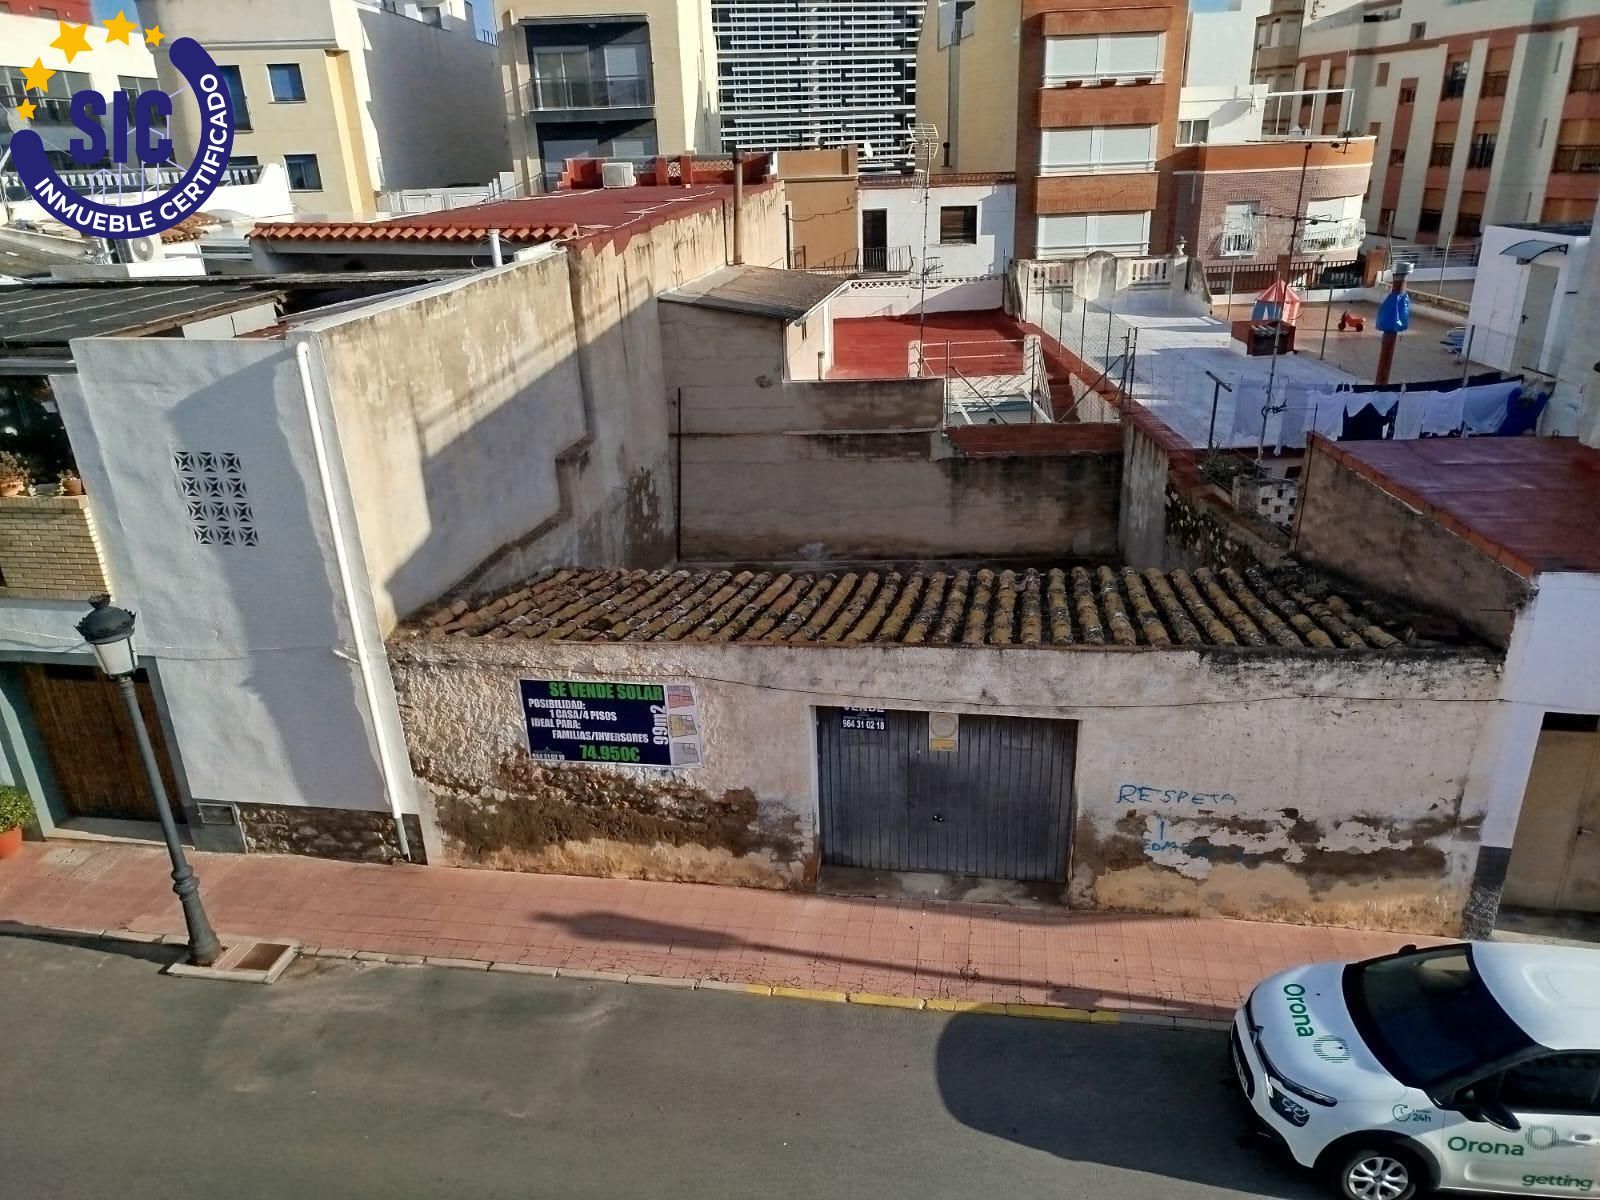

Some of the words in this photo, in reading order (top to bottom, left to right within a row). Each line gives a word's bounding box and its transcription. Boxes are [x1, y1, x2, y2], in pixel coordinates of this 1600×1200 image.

[549, 682, 567, 697] SE
[569, 683, 615, 699] VENDE
[616, 685, 664, 701] SOLAR
[528, 698, 586, 710] POSIBILIDAD:
[531, 717, 555, 728] IDEAL
[556, 719, 581, 729] PARA:
[550, 709, 555, 719] 1
[555, 709, 589, 720] CASA/4
[590, 710, 618, 721] PISOS
[650, 704, 669, 745] 99m2
[856, 720, 864, 729] 31
[866, 720, 875, 730] 02
[552, 729, 649, 744] FAMILIAS/INVERSORES
[579, 744, 640, 762] 74.950€
[1116, 784, 1237, 805] RESPETA
[1283, 983, 1314, 1037] Orona
[1412, 1113, 1432, 1122] 24h
[1447, 1136, 1525, 1156] Orona
[1522, 1174, 1593, 1191] getting
